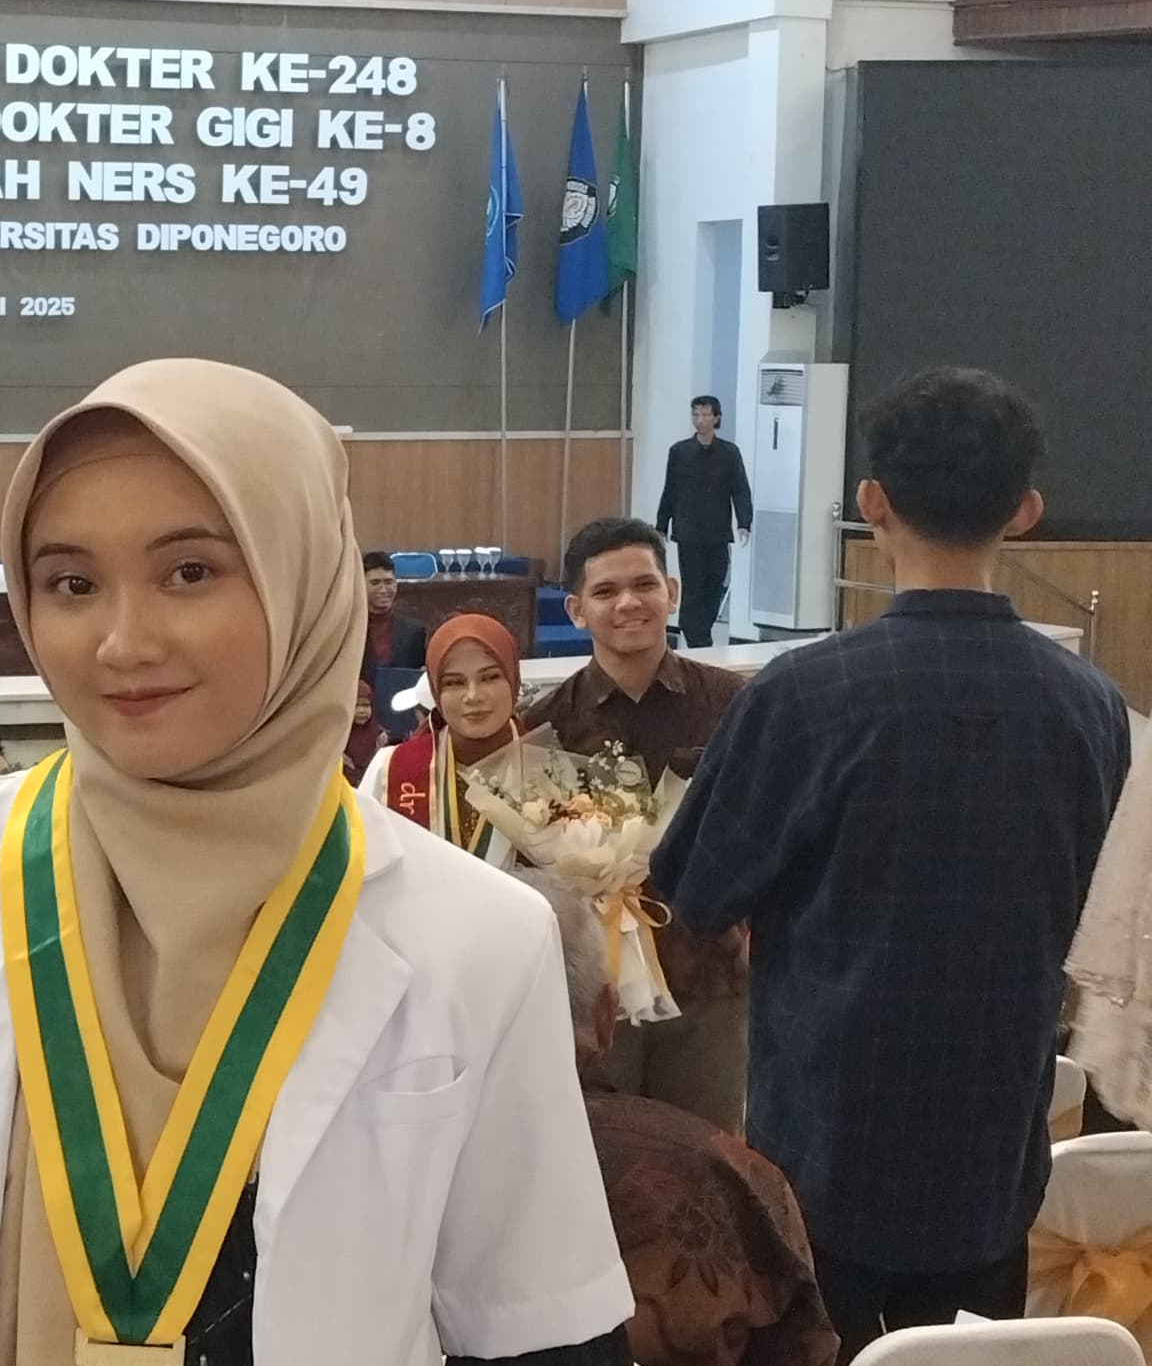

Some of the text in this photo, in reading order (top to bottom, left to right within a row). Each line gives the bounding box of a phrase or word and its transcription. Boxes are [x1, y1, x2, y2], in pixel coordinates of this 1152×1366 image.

[5, 42, 216, 90] DOKTER
[241, 51, 418, 96] KE-248
[196, 106, 294, 148] GIGI
[317, 109, 436, 151] KE-8
[68, 160, 196, 204] NERS
[221, 163, 368, 206] KE-49
[137, 222, 347, 253] DIPONEGORO
[20, 296, 76, 316] 2025
[399, 782, 426, 815] dr
